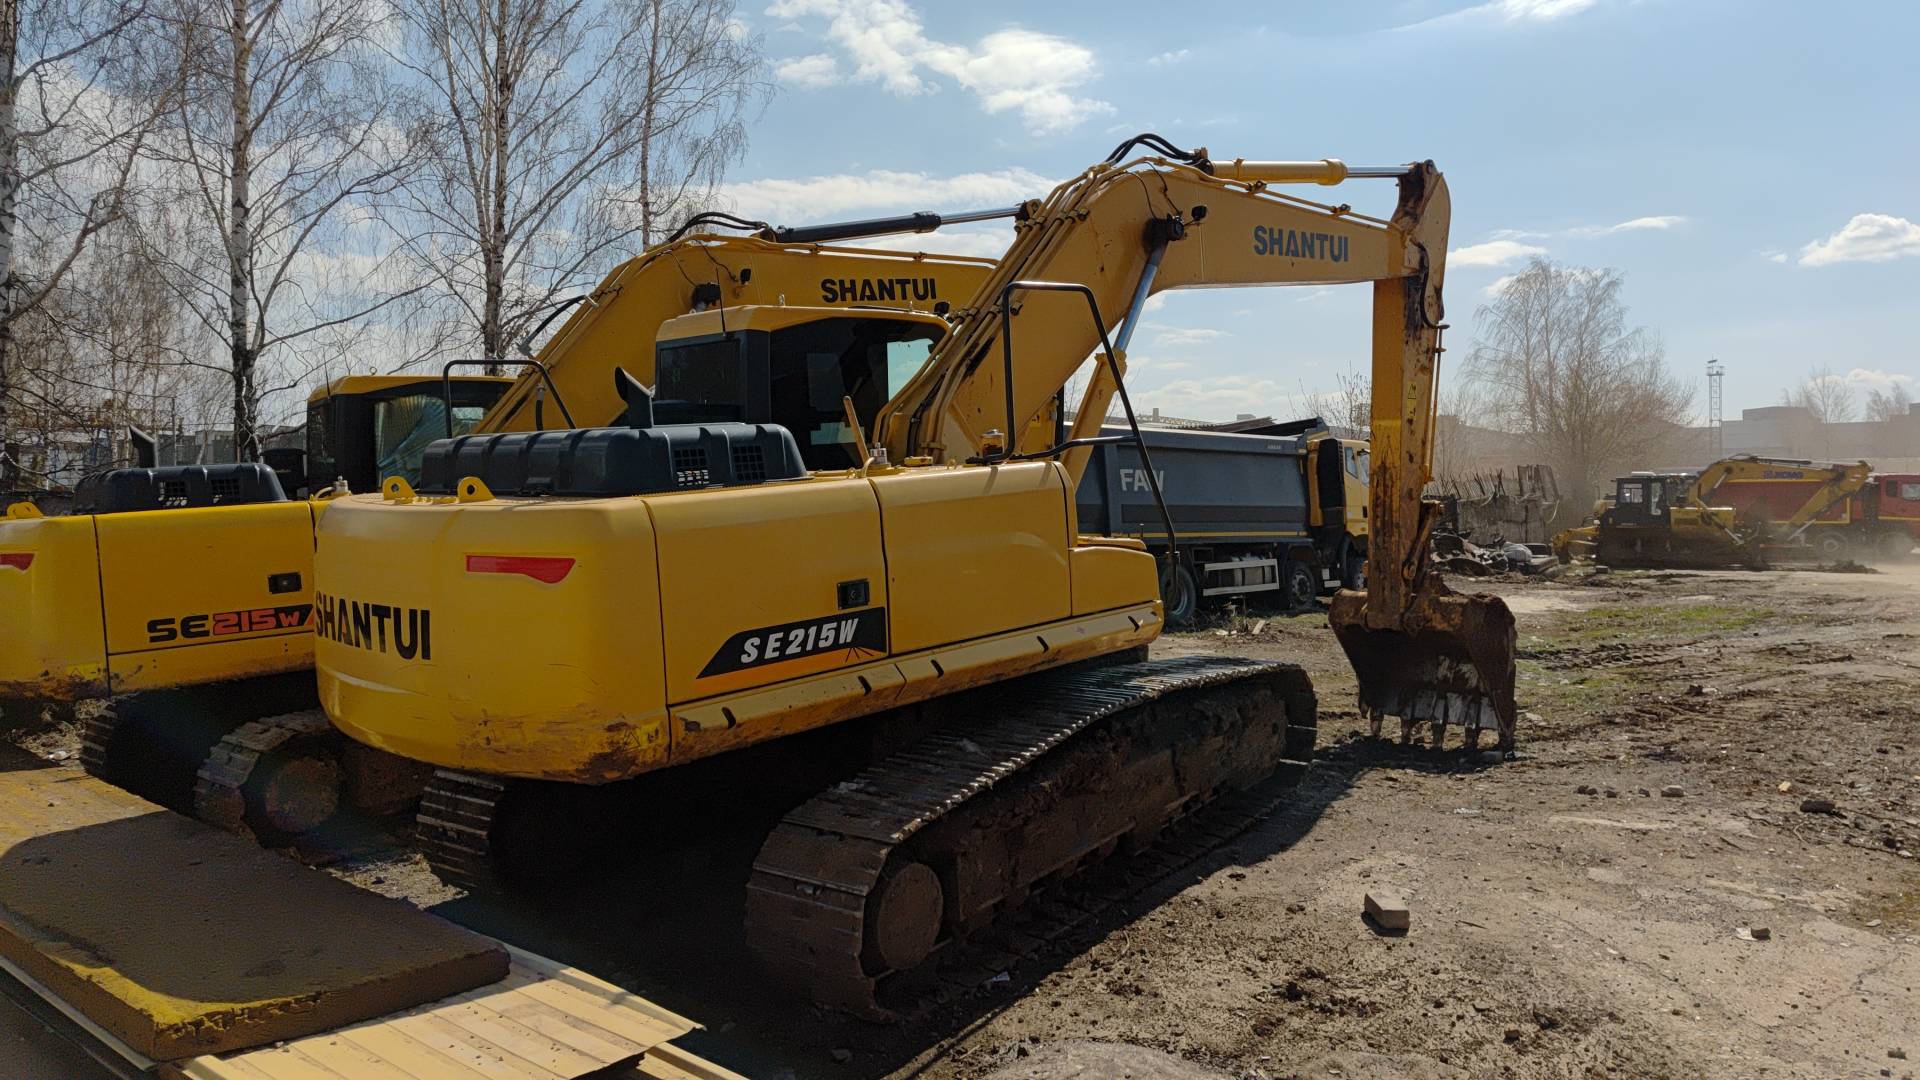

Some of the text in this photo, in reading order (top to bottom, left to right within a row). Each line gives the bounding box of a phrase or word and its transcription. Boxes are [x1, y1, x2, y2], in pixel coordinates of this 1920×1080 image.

[1253, 225, 1349, 263] SHANTUI
[820, 278, 937, 303] SHANTUI
[315, 590, 431, 661] SHANTUI
[740, 618, 859, 665] SE215W
